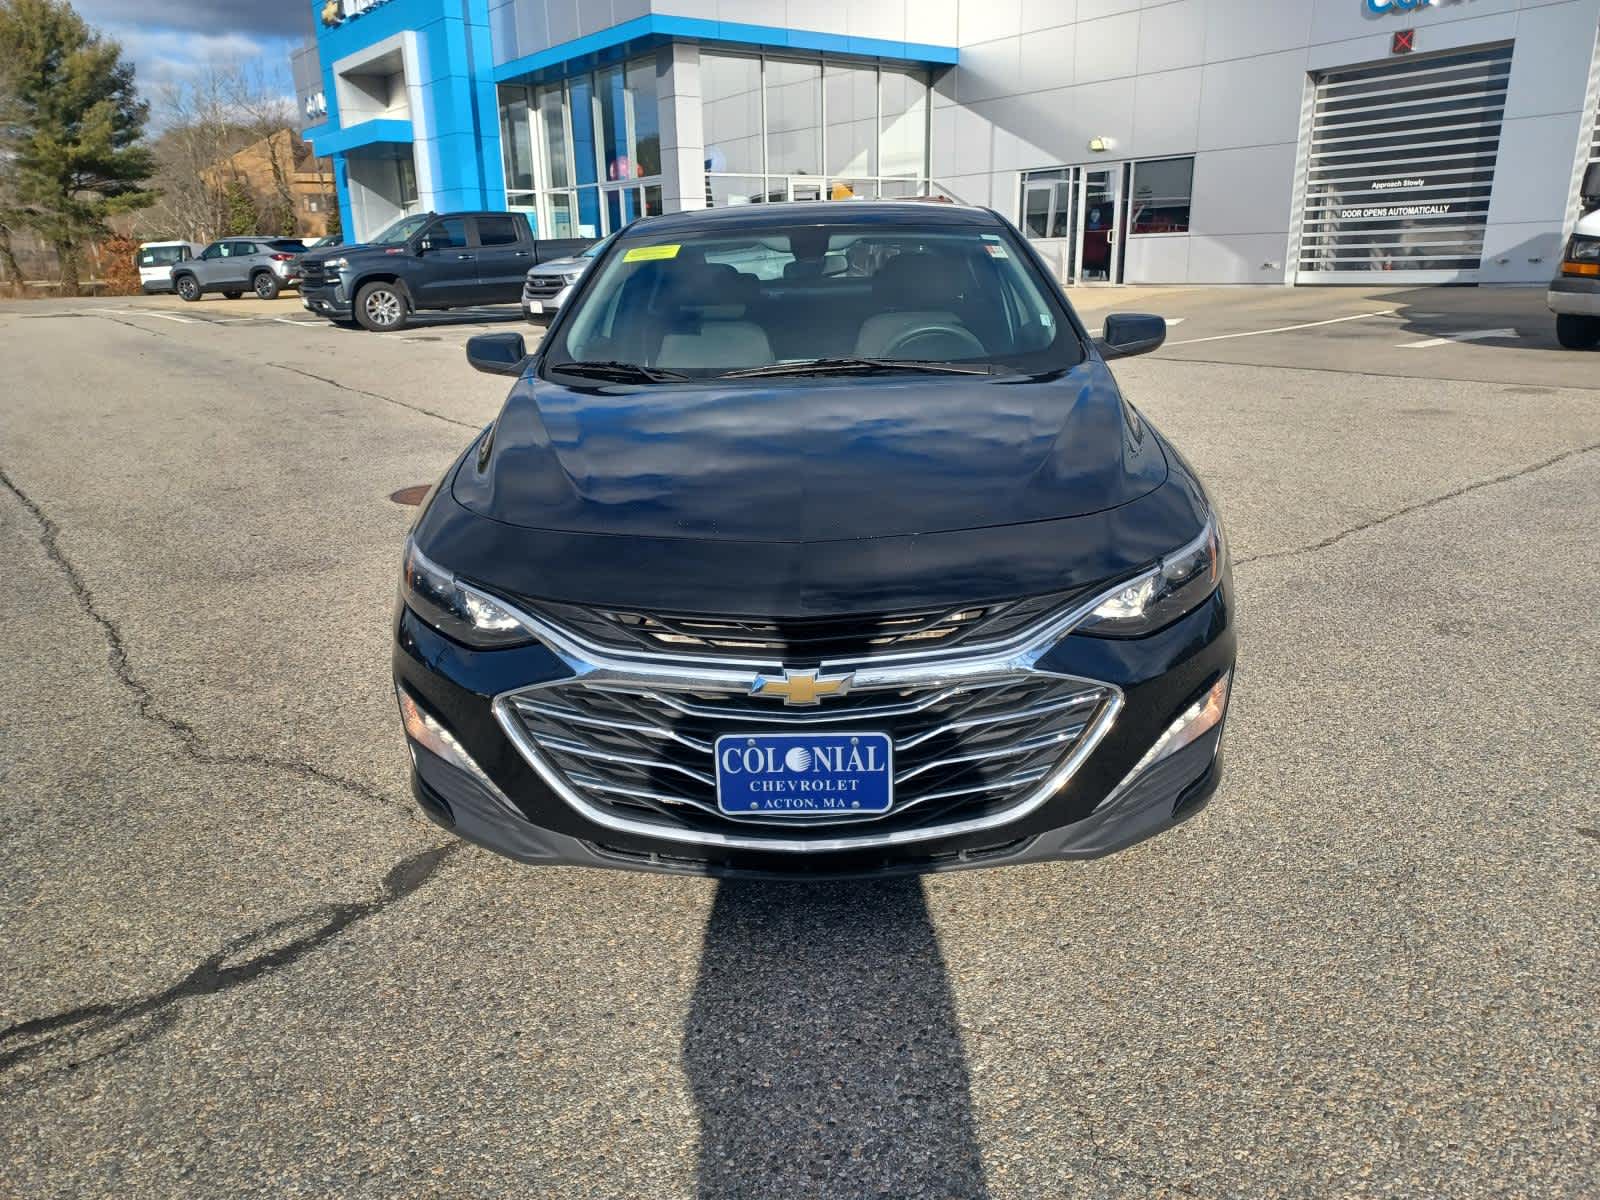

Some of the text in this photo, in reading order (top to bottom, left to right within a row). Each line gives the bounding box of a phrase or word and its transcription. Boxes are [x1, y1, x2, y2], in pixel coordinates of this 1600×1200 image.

[1371, 179, 1425, 190] Approach Slowly
[1341, 205, 1450, 218] DOOR OPENS AUTOMATICALLY
[721, 745, 886, 775] COLONIAL
[749, 779, 860, 792] CHEVROLET
[764, 798, 846, 809] ACTON, MA
